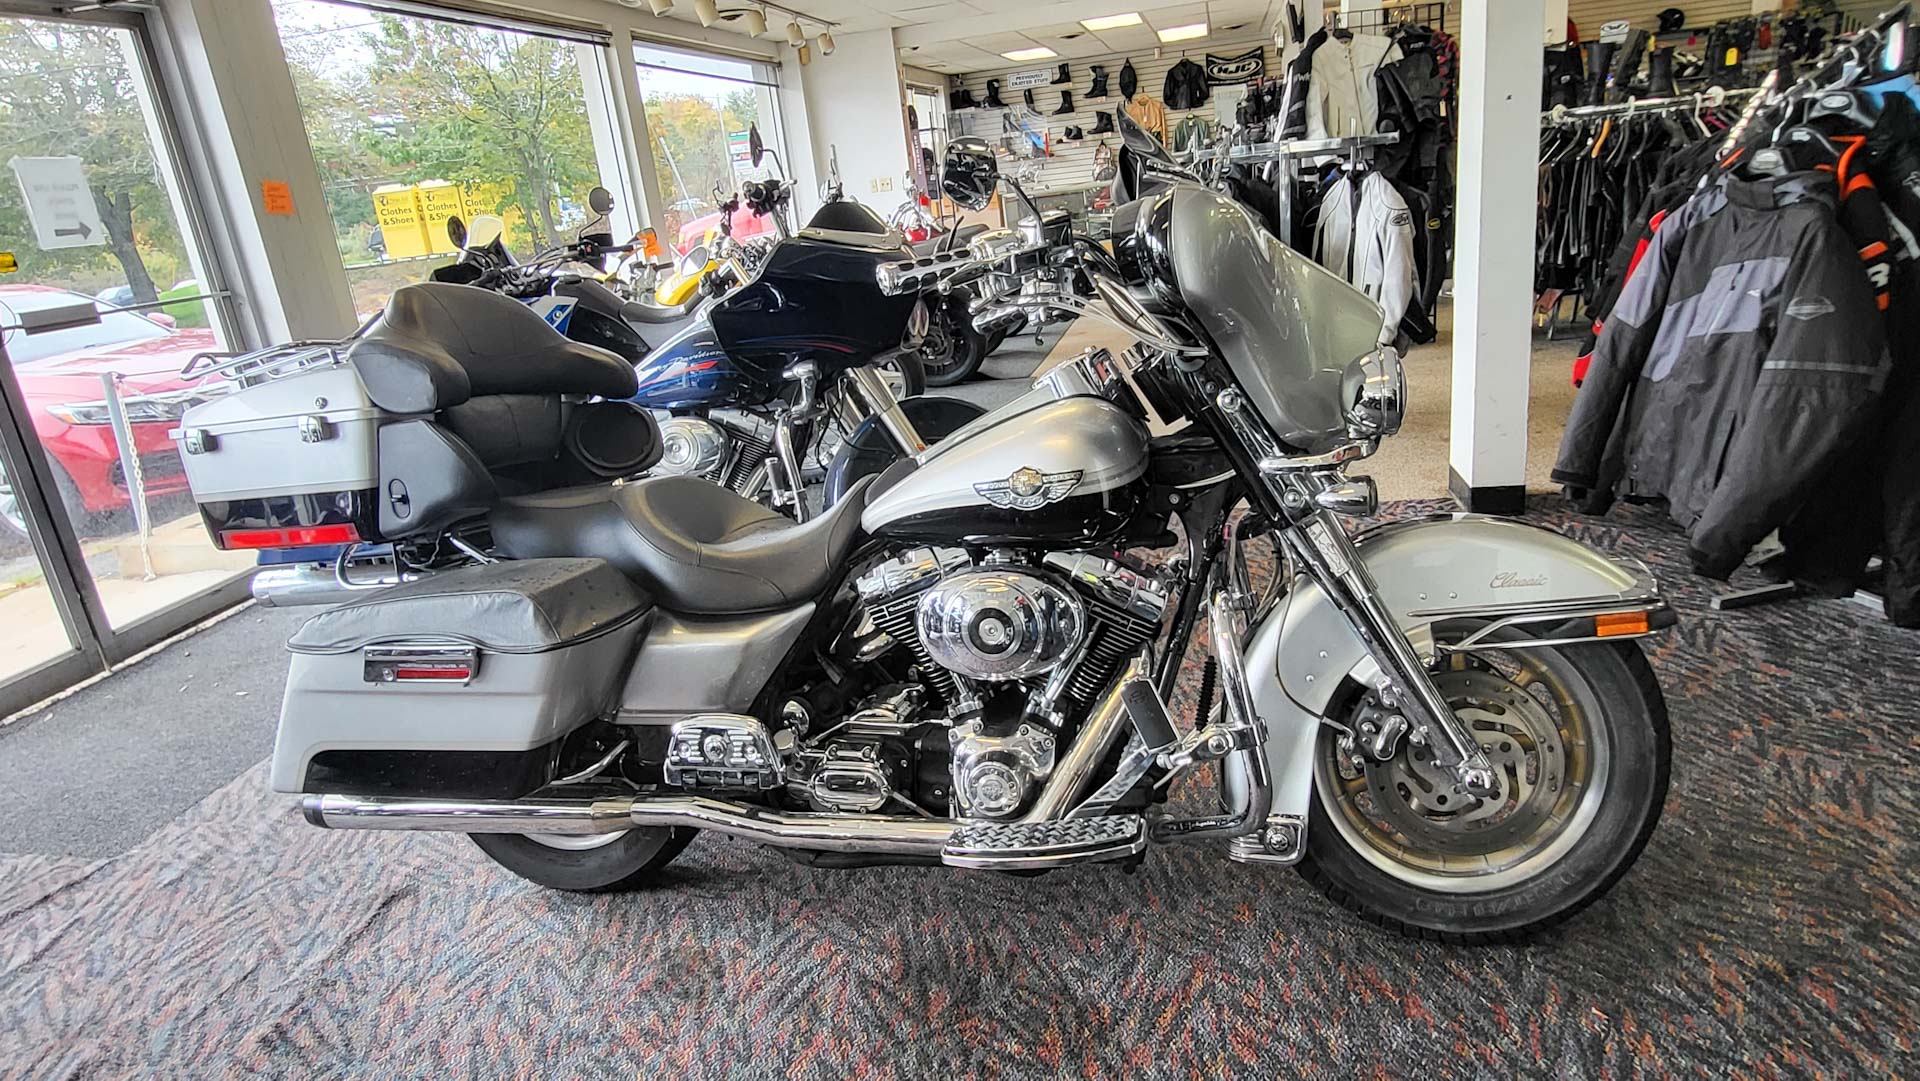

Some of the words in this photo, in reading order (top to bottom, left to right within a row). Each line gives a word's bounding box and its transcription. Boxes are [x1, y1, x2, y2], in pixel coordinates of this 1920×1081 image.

[1216, 61, 1253, 75] HJC
[1015, 73, 1043, 81] PREVIOUSLY
[1011, 79, 1033, 87] ENJOYED
[380, 206, 412, 217] Clothes
[426, 202, 458, 212] Clothes
[429, 213, 435, 221] &
[467, 208, 474, 217] &
[383, 217, 390, 226] &
[390, 216, 415, 225] Shoes
[1489, 572, 1549, 589] Classic
